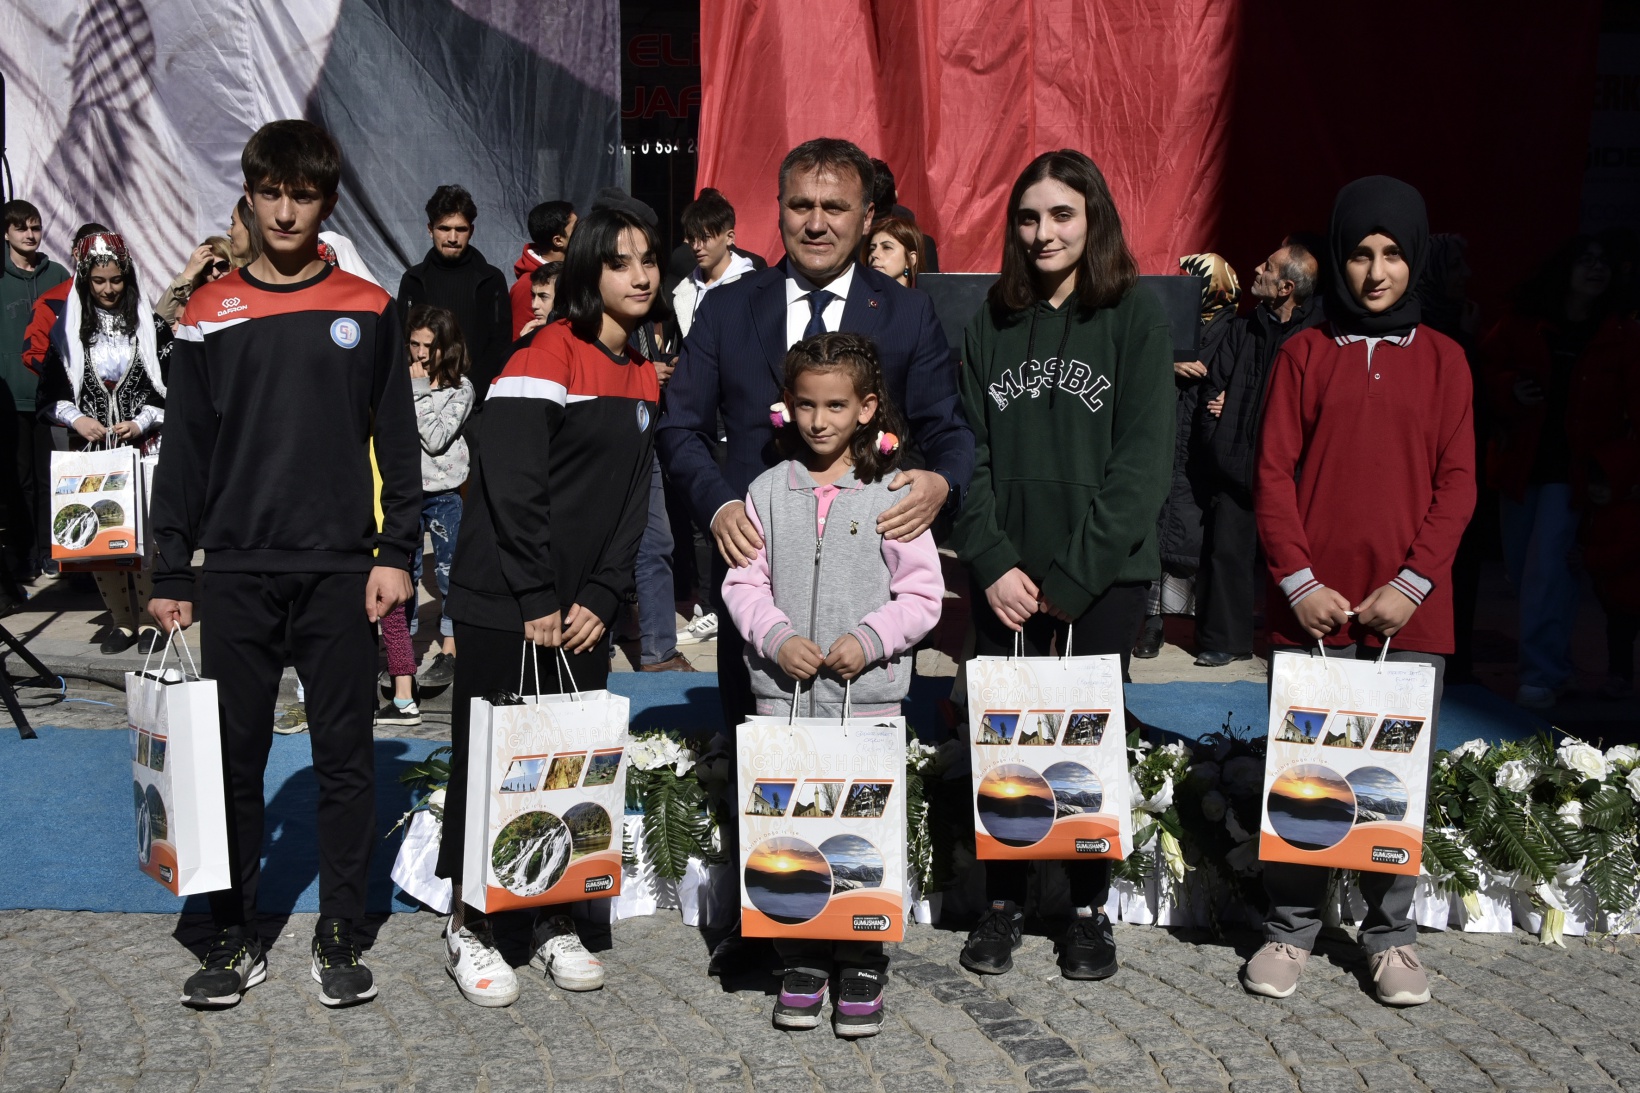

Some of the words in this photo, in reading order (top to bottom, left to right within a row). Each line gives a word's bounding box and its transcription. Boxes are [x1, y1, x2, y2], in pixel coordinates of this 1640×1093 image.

[655, 138, 681, 155] 534
[981, 684, 1110, 705] GÜMÜŞHANE
[1287, 682, 1427, 710] GÜMÜŞHANE
[752, 750, 894, 775] GÜMÜŞHANE
